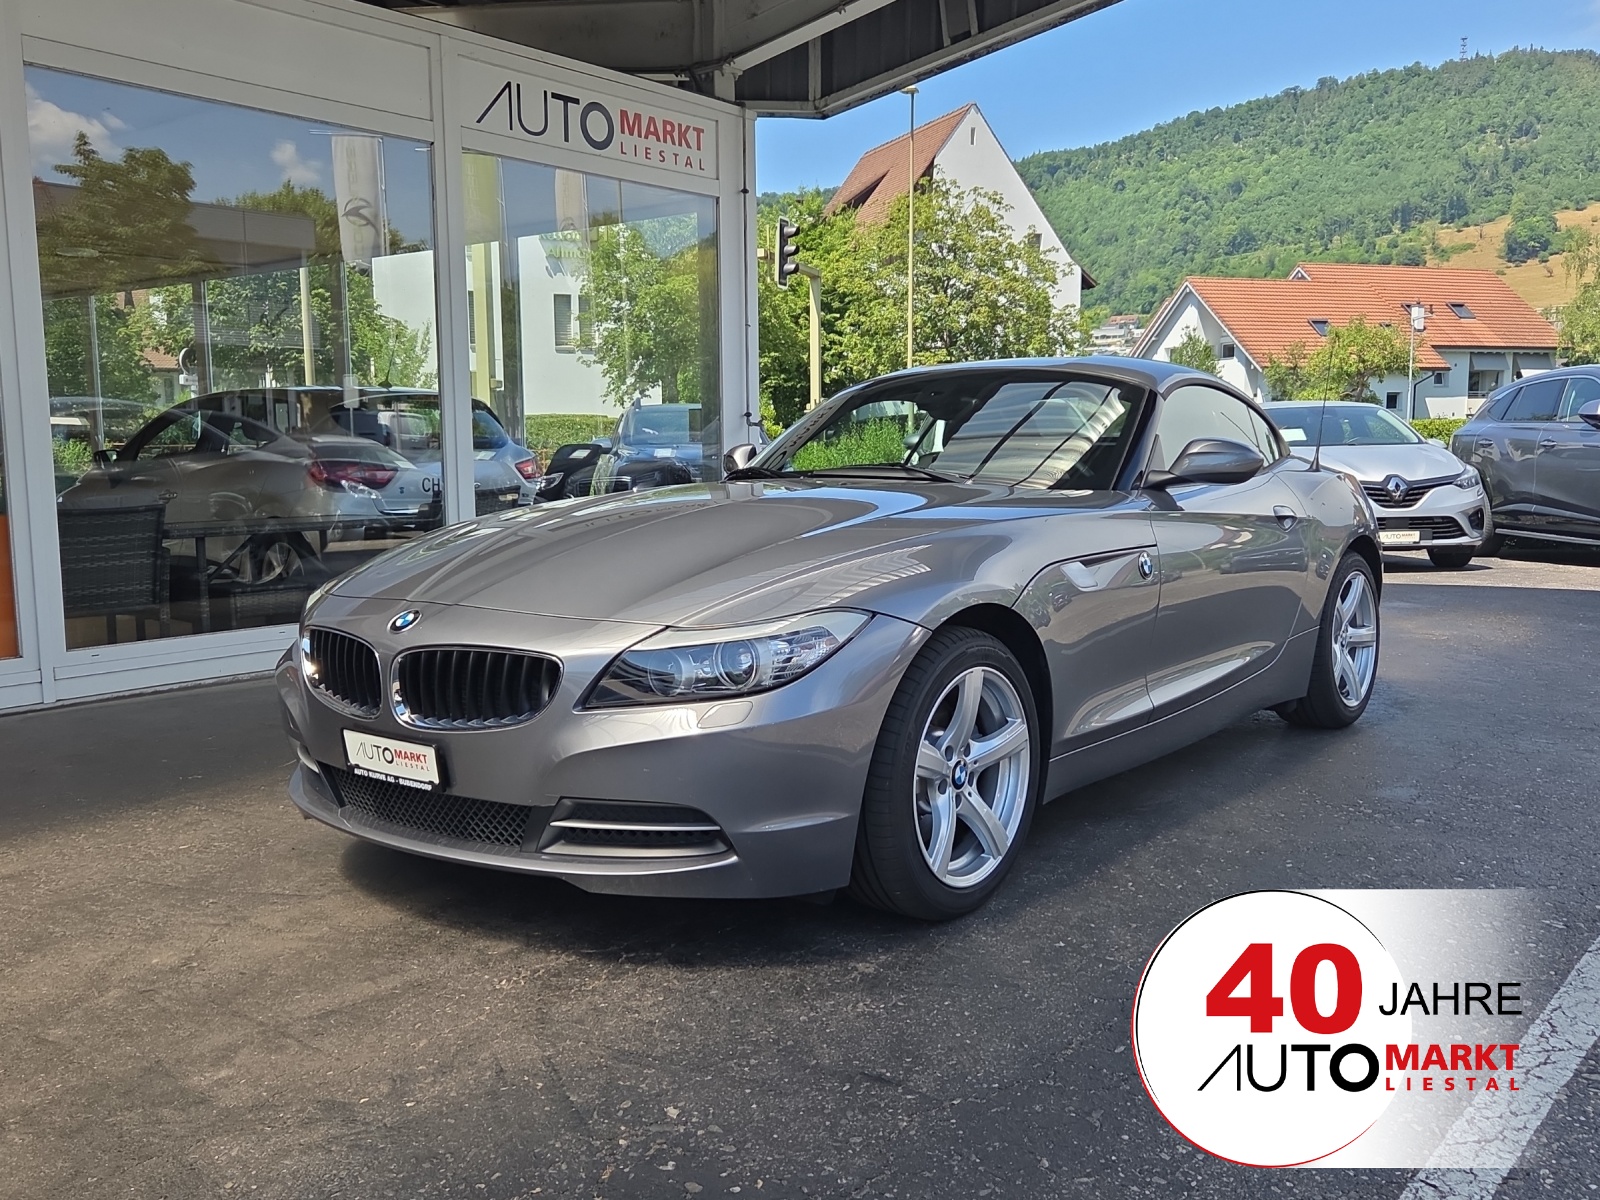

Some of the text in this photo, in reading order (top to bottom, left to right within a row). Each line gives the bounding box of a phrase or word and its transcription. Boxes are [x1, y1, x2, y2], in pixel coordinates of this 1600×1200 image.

[476, 81, 705, 152] AUTO MARKT
[620, 141, 705, 171] LIESTAL
[356, 742, 427, 764] AUTO MARKT
[354, 768, 368, 777] AUTO
[396, 761, 430, 771] LIESTAL
